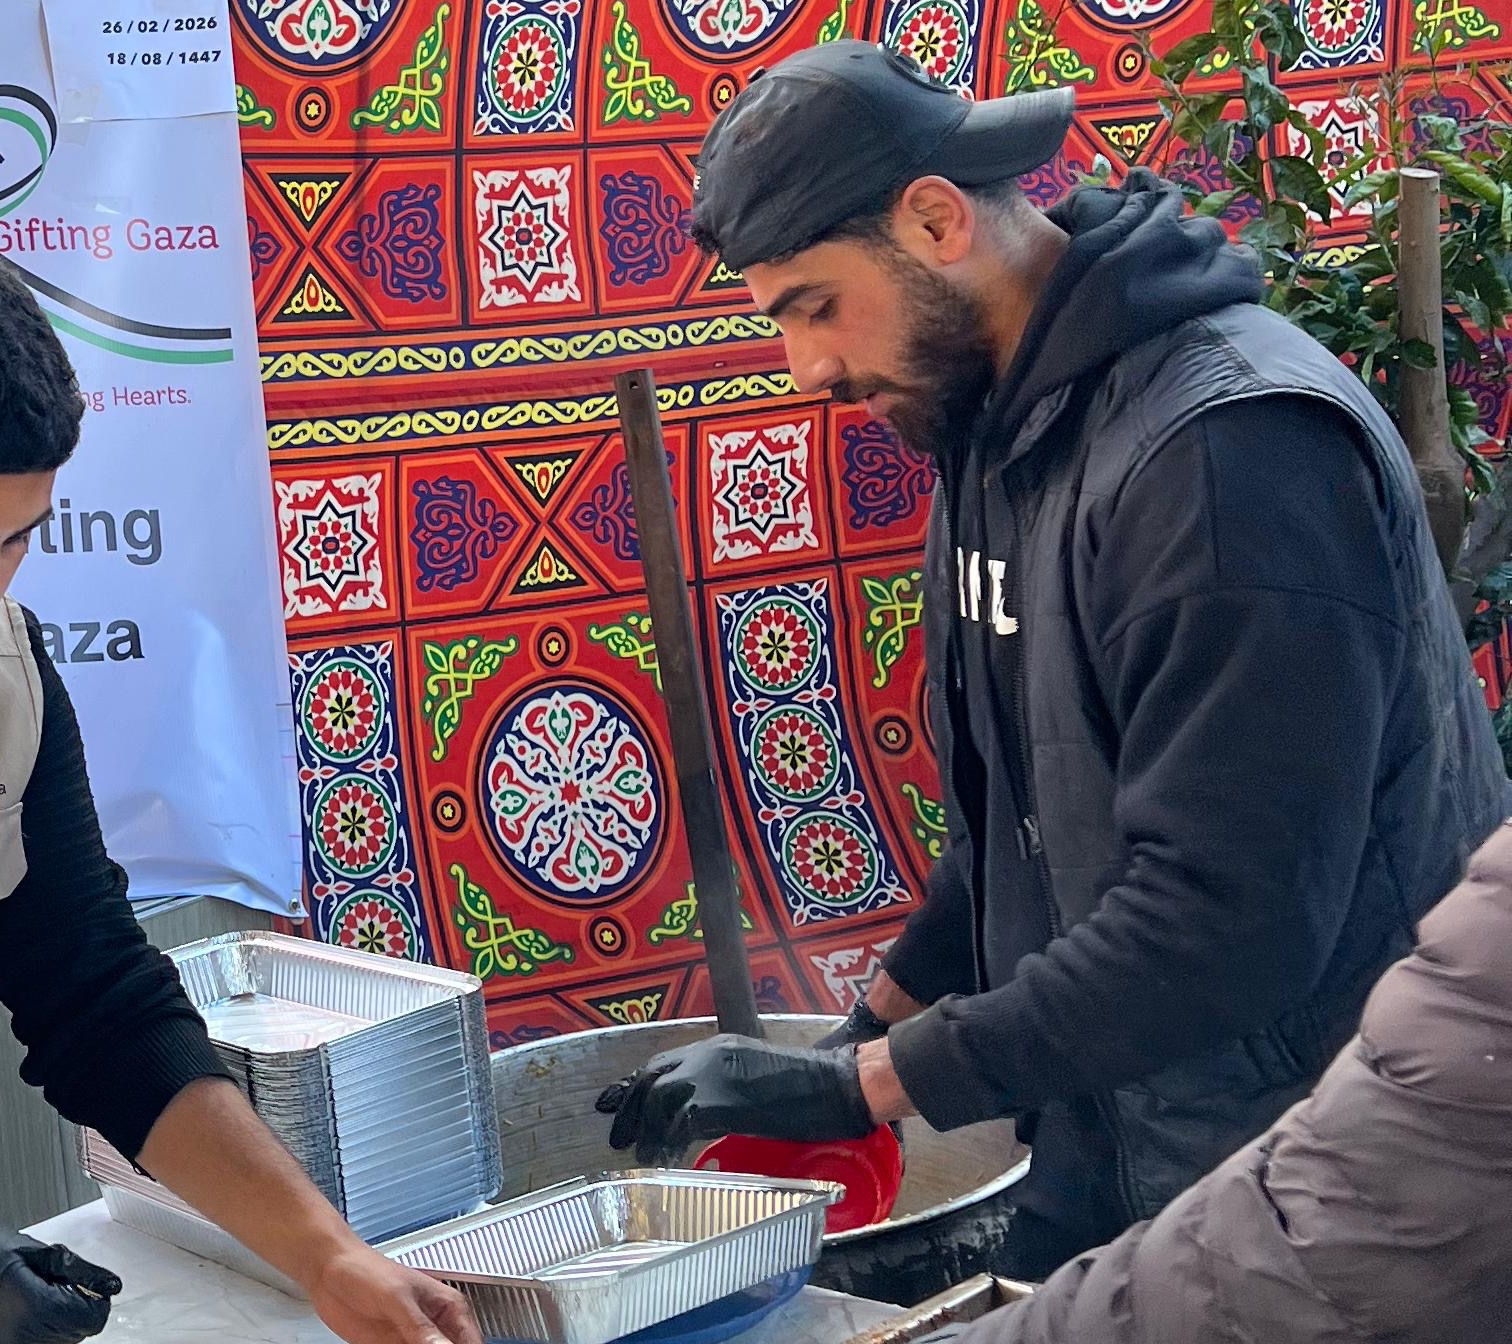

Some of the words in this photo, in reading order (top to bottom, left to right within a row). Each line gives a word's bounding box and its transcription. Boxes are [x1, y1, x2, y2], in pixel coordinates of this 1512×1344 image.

[174, 16, 218, 31] 2026
[179, 50, 222, 64] 1447
[126, 218, 220, 251] Gaza
[111, 385, 192, 407] Hearts.
[39, 498, 163, 566] ting
[41, 619, 146, 664] aza
